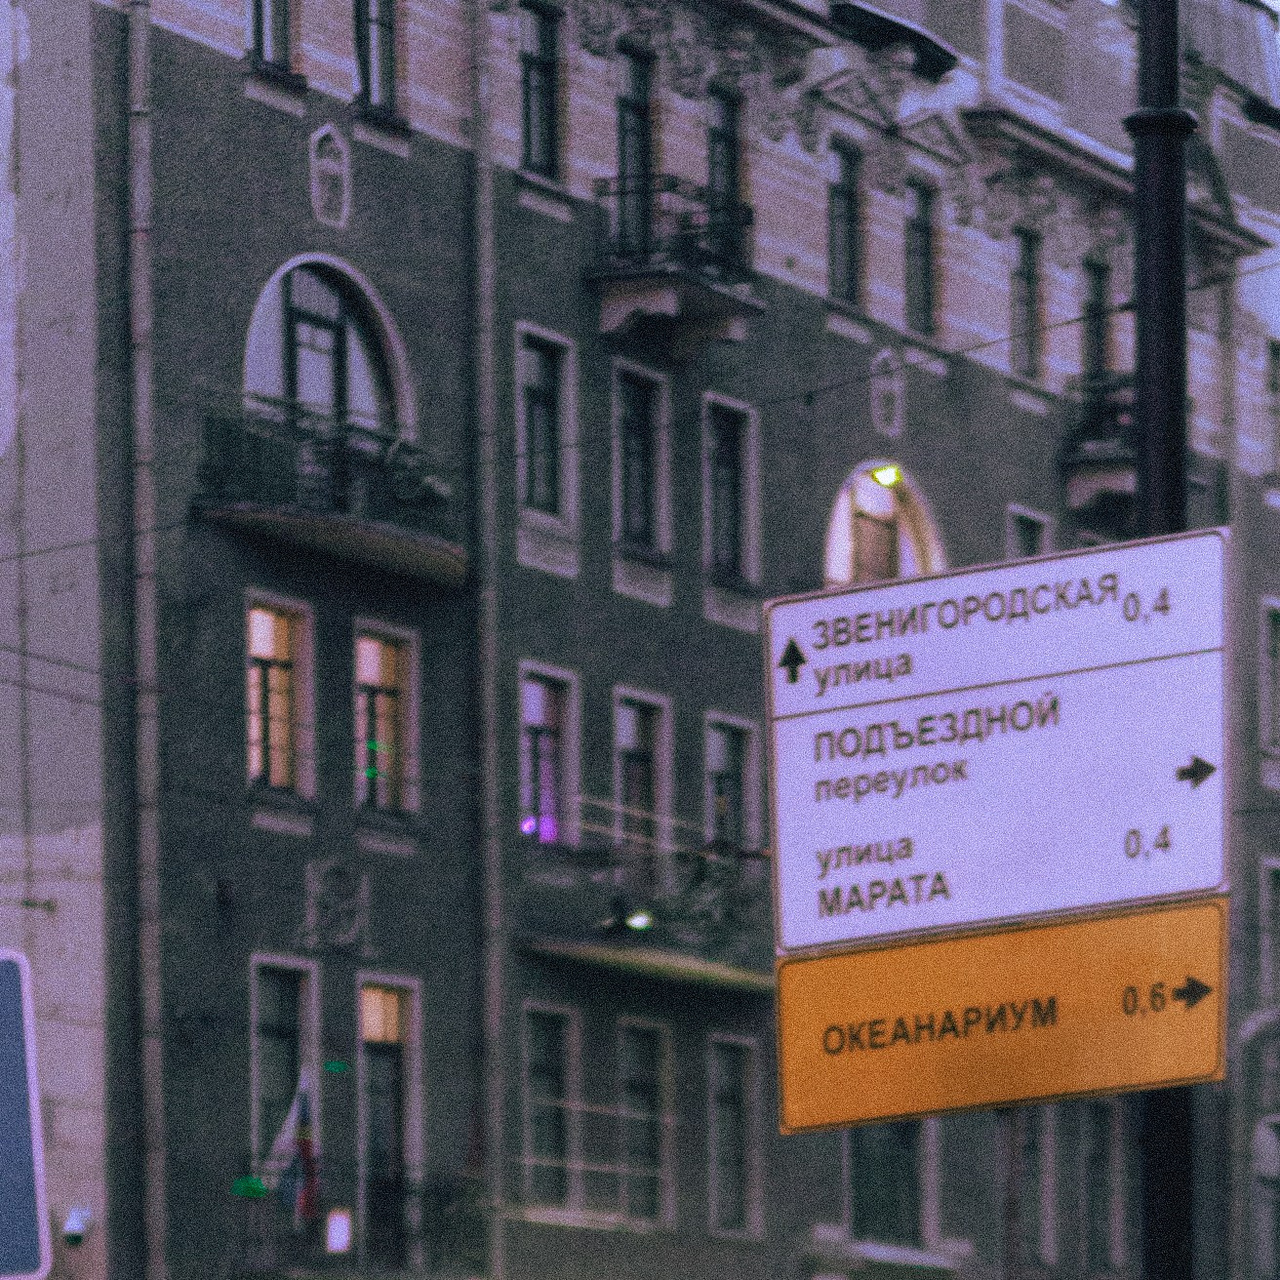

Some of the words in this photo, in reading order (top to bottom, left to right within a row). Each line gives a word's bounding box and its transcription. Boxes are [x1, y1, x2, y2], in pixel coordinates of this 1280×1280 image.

[811, 573, 1120, 649] ЗВЕНИГОРОДСКАЯ
[1122, 587, 1171, 622] 0,4
[813, 654, 912, 695] улица
[814, 691, 1060, 761] ПОДЪЕЗДНОЙ
[814, 760, 967, 803] переулок
[816, 832, 914, 878] улица
[1124, 825, 1171, 860] 0,4
[817, 873, 950, 918] МАРАТА
[821, 998, 1058, 1055] ОКЕАНАРИУМ
[1122, 982, 1166, 1017] 0,6
